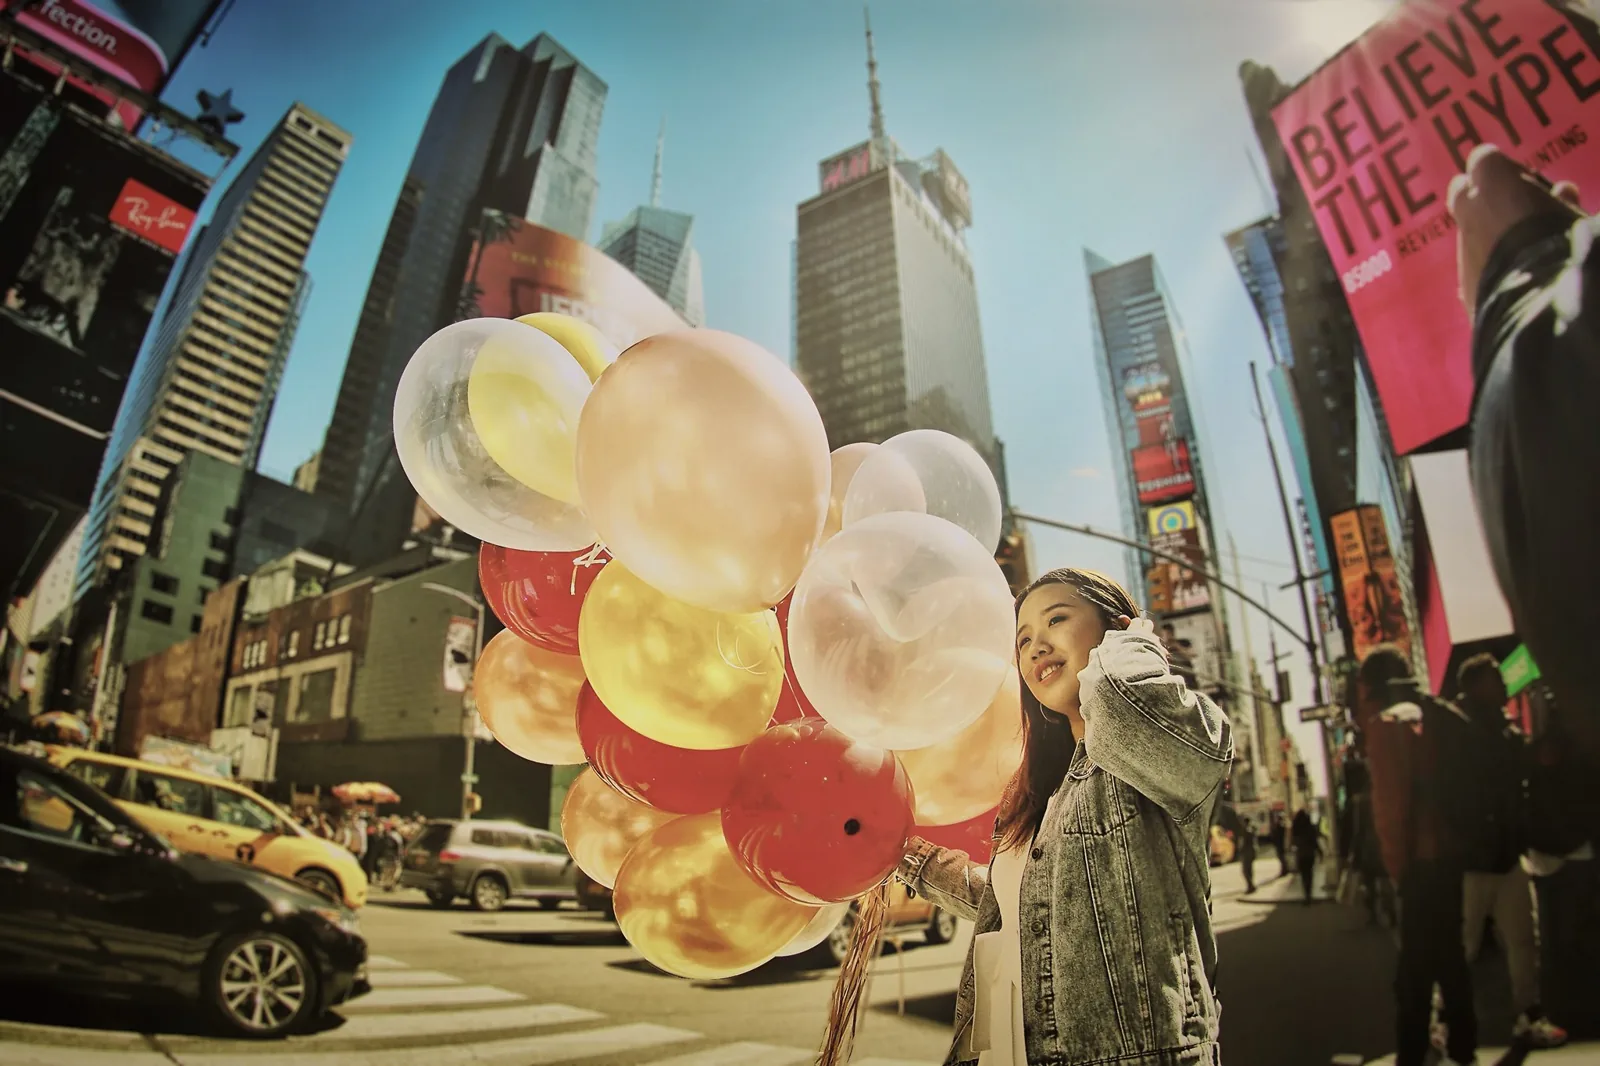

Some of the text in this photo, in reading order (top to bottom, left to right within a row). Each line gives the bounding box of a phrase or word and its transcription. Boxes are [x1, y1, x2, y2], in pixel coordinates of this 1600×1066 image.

[38, 0, 117, 55] fection.
[1290, 0, 1522, 191] BELIEVE
[1314, 23, 1600, 257] THE HYPE
[124, 196, 187, 233] Ray-Ban
